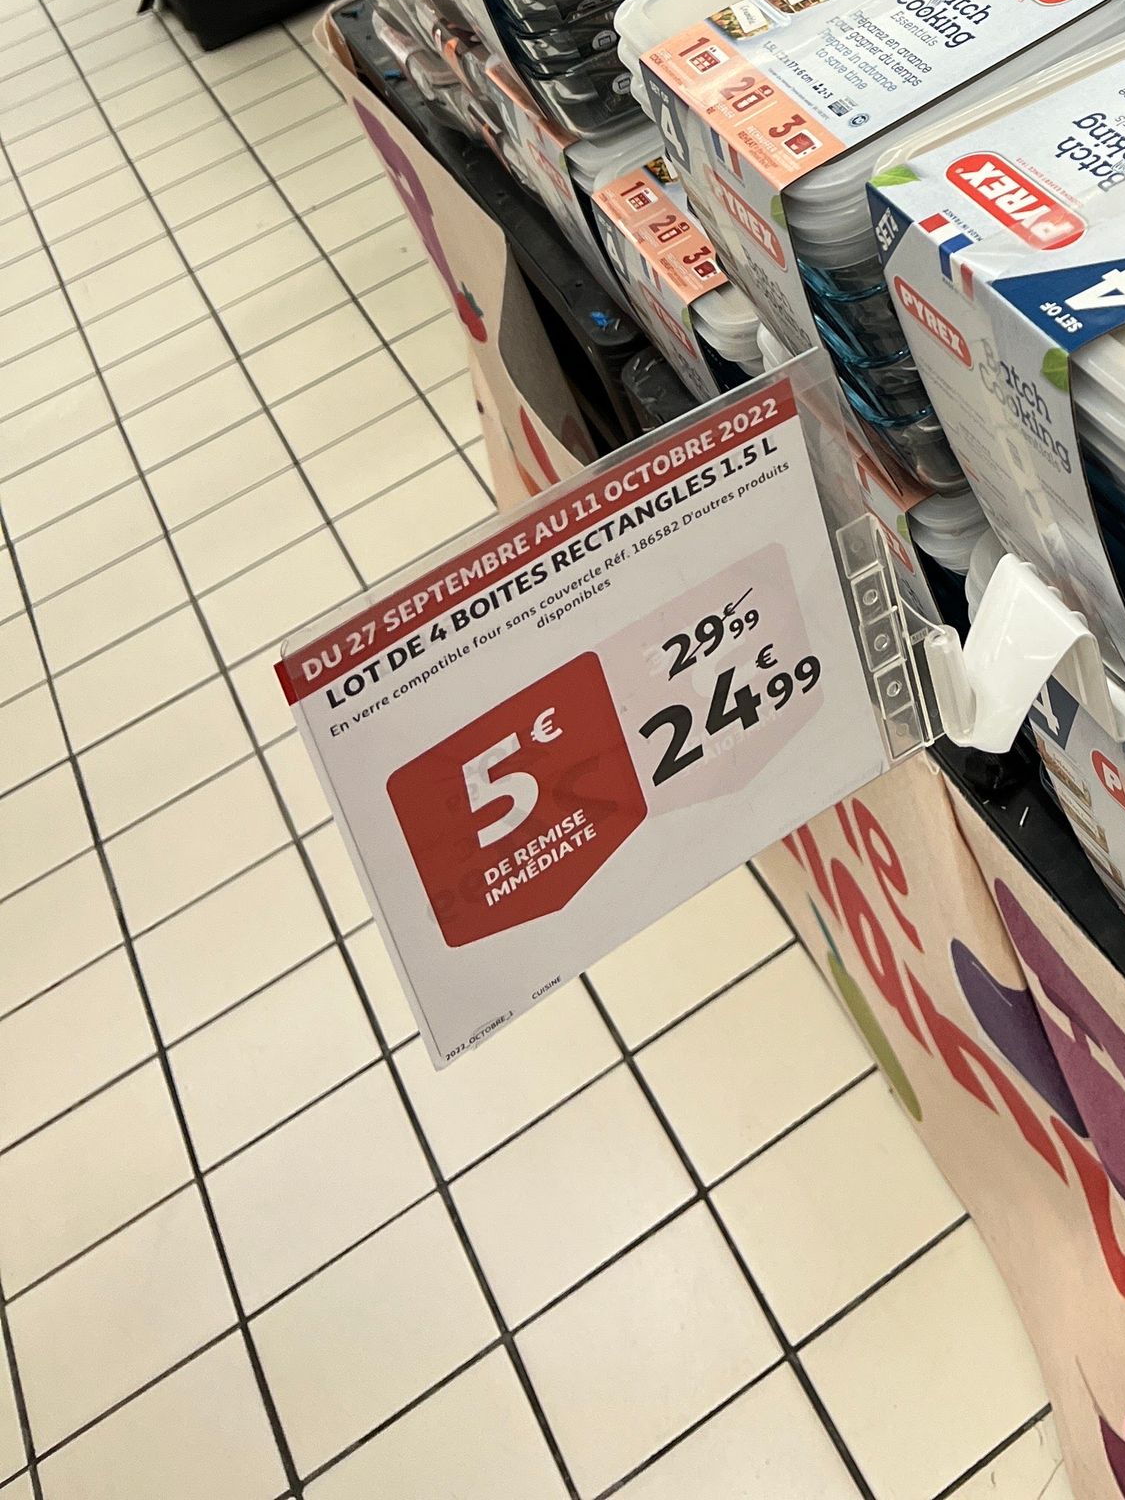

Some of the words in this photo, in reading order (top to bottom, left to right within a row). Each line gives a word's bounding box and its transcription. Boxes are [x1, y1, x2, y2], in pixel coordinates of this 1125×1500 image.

[890, 11, 940, 47] Essentials
[962, 161, 1073, 245] PYREX
[900, 284, 963, 357] PYREX
[1054, 313, 1083, 333] SET
[302, 644, 342, 682] DU
[346, 621, 377, 656] 27
[384, 532, 530, 633] SEPTEMBRE
[534, 510, 569, 545] AU
[572, 492, 602, 522] 11
[604, 430, 716, 502] OCTOBRE
[718, 397, 778, 443] 2022
[326, 660, 381, 709] LOT
[386, 635, 425, 672] DE
[430, 624, 447, 643] 4
[450, 562, 549, 632] BOITES
[551, 467, 717, 574] RECTANGLES
[720, 443, 758, 479] 1.5
[762, 437, 778, 457] L
[330, 721, 350, 738] En
[352, 696, 390, 724] verre
[392, 644, 471, 699] compatible
[472, 625, 502, 649] four
[505, 607, 537, 631] sans
[539, 564, 602, 610] couvercle
[604, 548, 631, 571] Réf.
[631, 521, 680, 555] 186582
[682, 491, 735, 526] D'autres
[737, 462, 790, 499] produits
[536, 577, 611, 629] disponibles
[484, 861, 513, 886] DE
[514, 809, 587, 866] REMISE
[485, 823, 597, 907] IMMÉDIATE
[531, 975, 563, 1000] CUISINE
